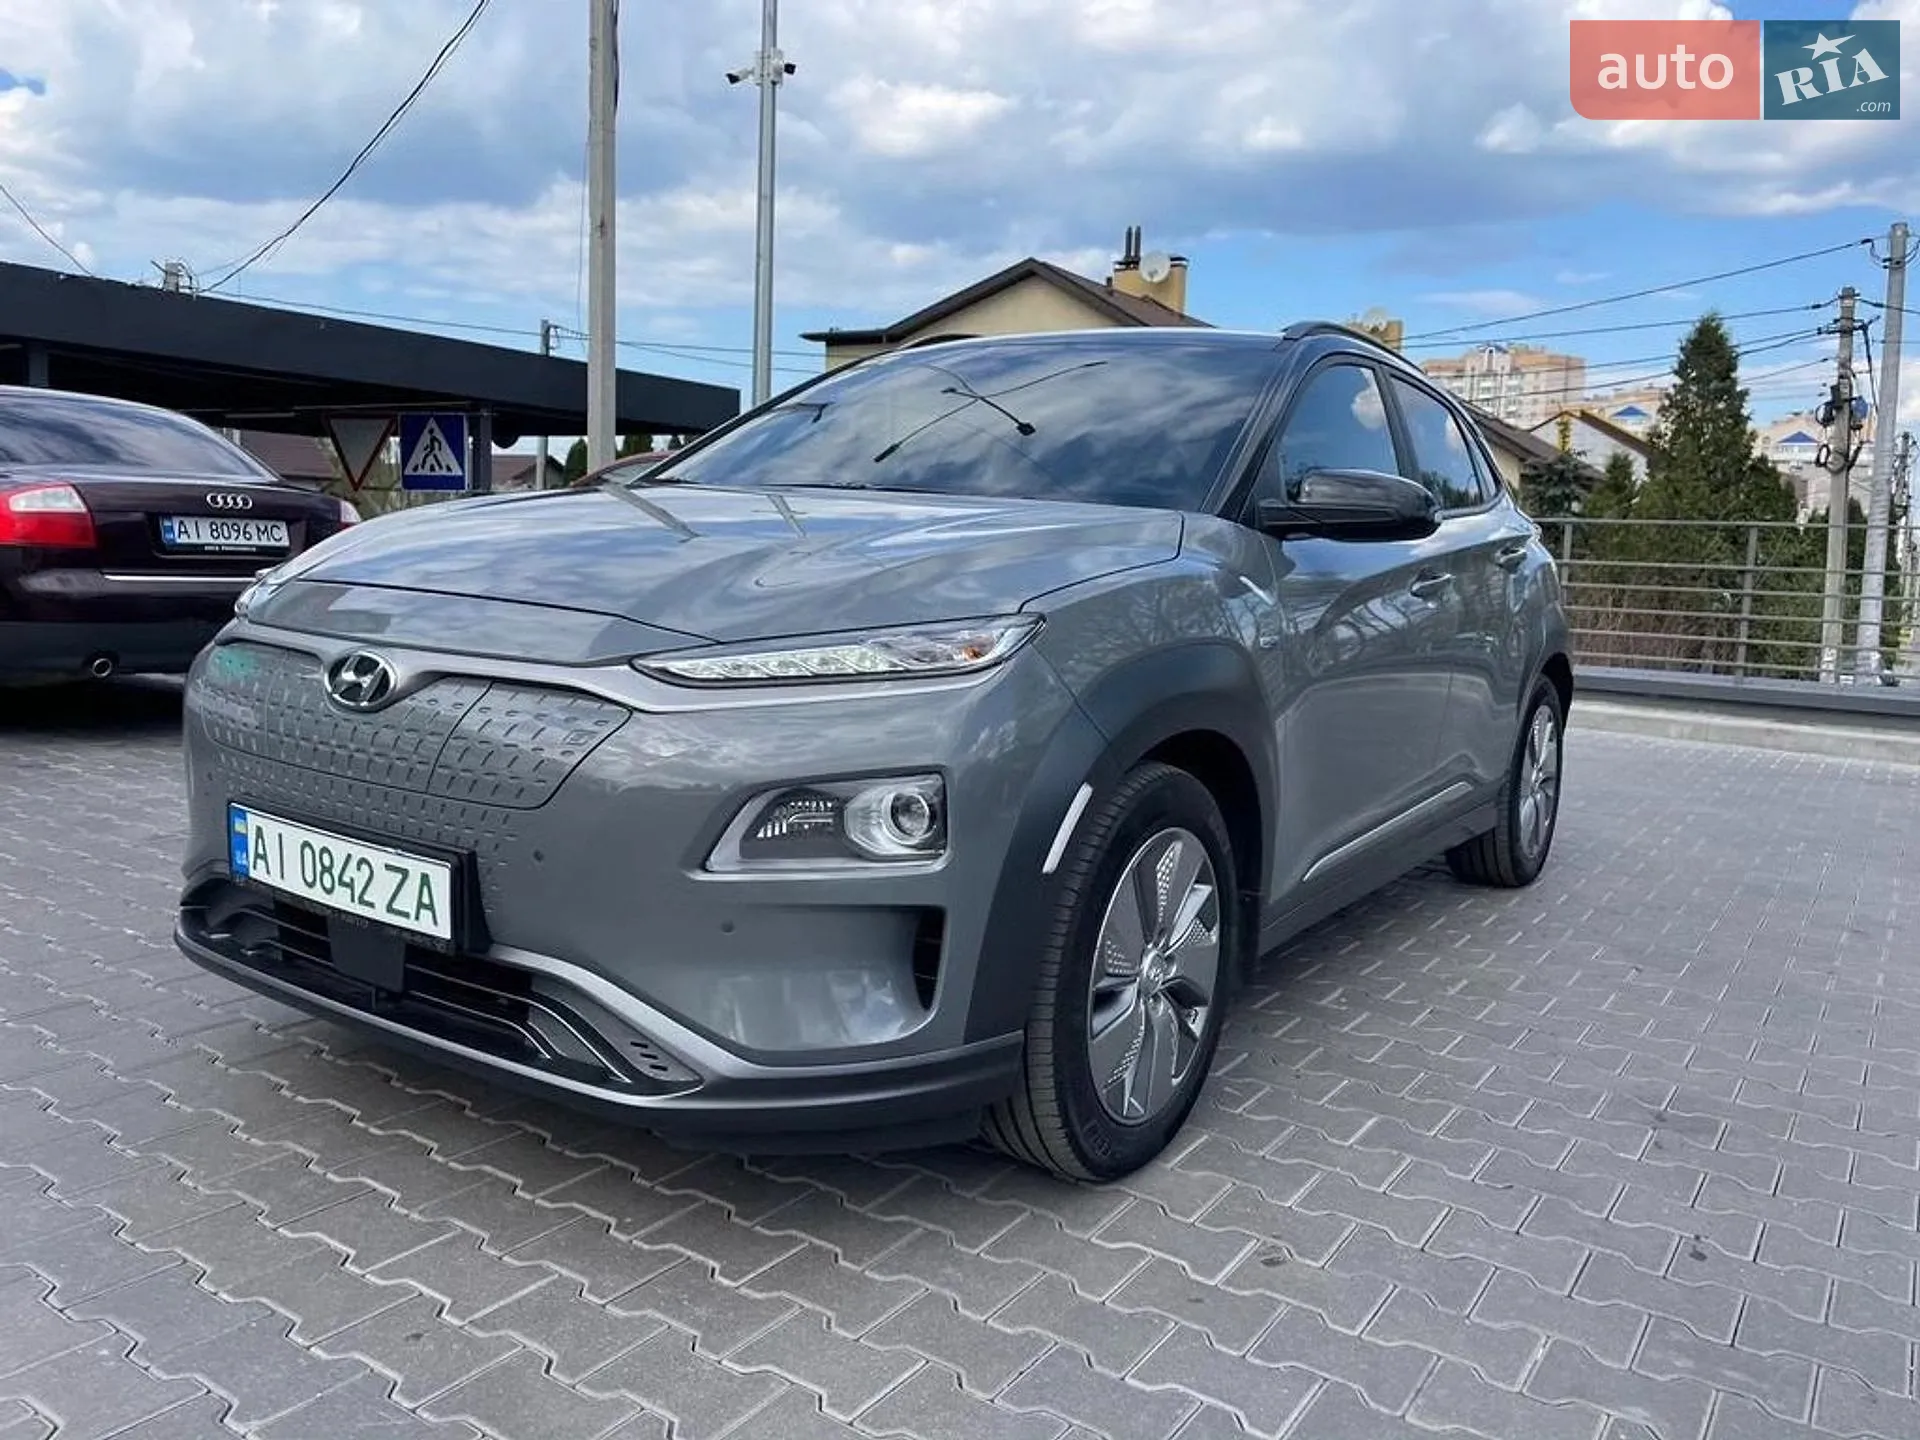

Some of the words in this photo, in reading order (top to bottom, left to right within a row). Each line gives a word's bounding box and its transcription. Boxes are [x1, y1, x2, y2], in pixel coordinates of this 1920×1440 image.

[177, 519, 200, 539] AI
[209, 520, 252, 541] 8096
[255, 524, 283, 542] MC
[252, 825, 285, 880] AI
[299, 839, 376, 909] 0842
[384, 863, 438, 926] ZA
